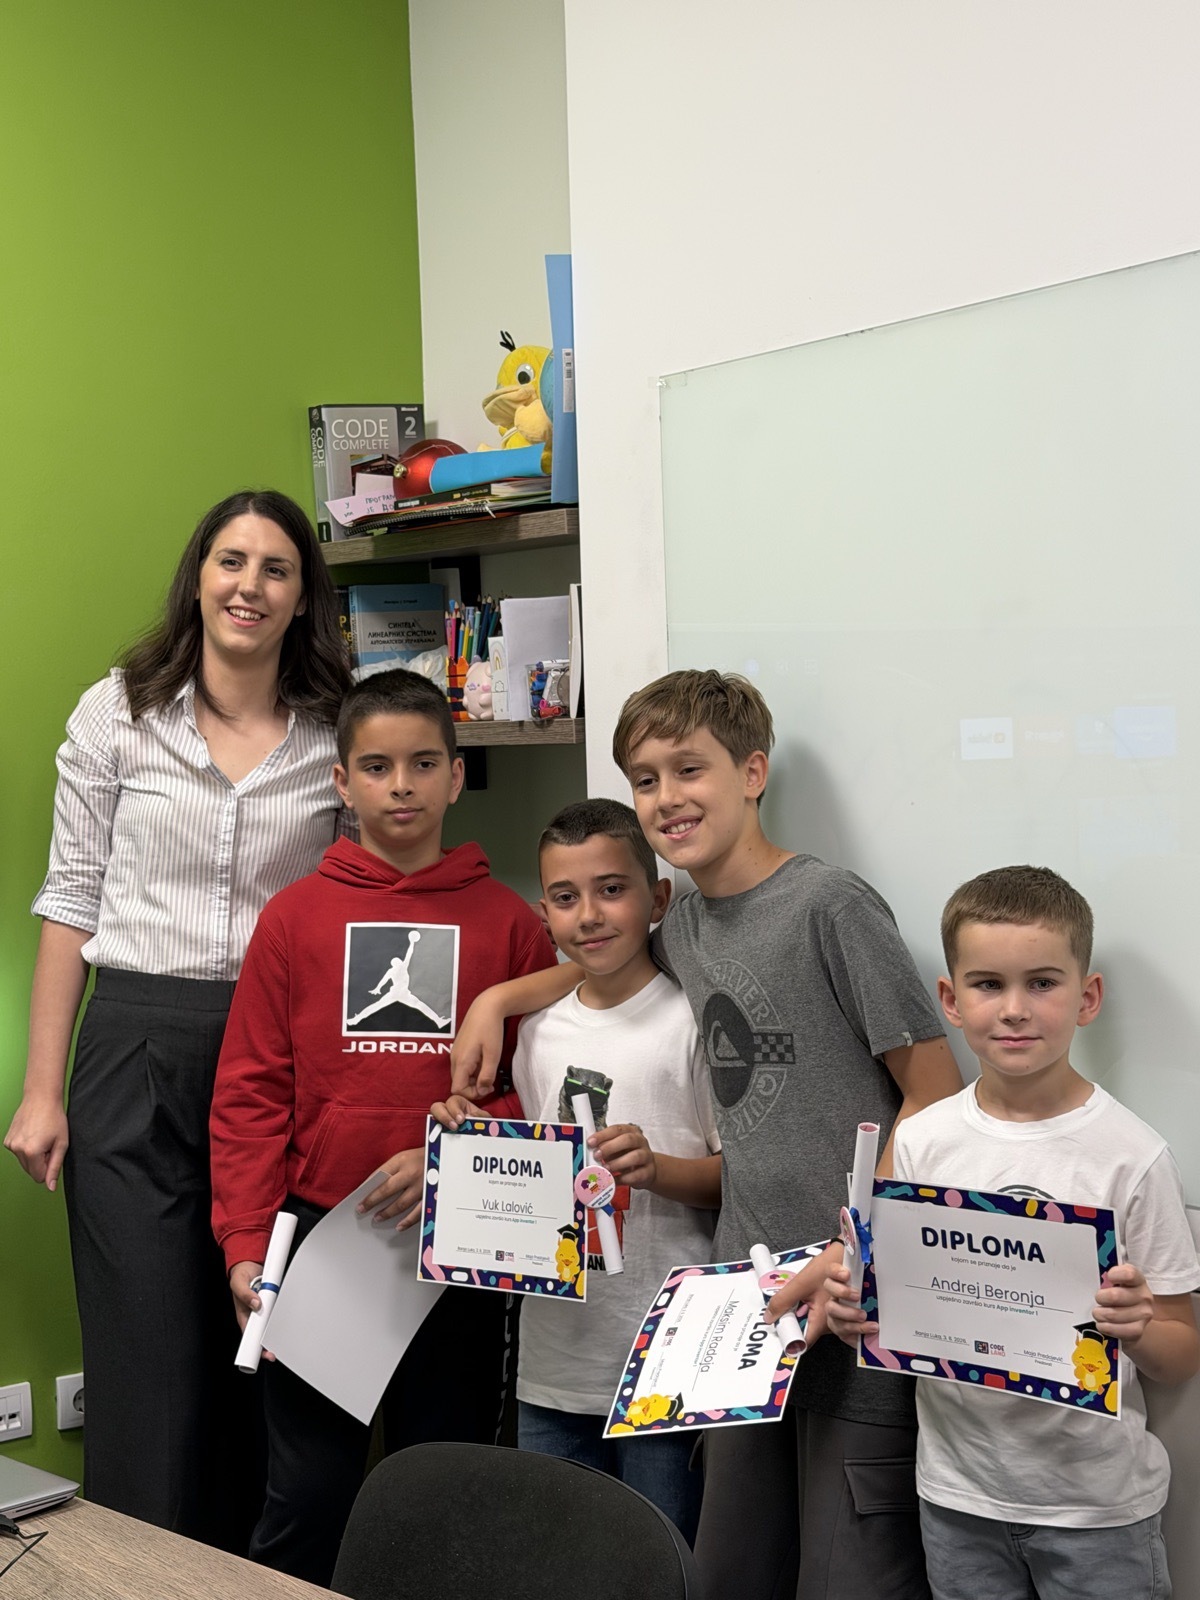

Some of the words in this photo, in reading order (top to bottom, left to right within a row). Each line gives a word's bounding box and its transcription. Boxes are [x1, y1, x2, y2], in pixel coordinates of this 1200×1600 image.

[331, 419, 389, 438] CODE
[404, 416, 417, 436] 2
[310, 428, 318, 467] COMPLETE
[315, 427, 326, 467] CODE
[332, 440, 389, 451] COMPLETE
[712, 965, 771, 1022] SILVER
[342, 1041, 453, 1054] JORDAN
[473, 1155, 543, 1179] DIPLOMA
[482, 1198, 499, 1211] Vuk
[501, 1200, 533, 1215] Lalović
[921, 1226, 1046, 1264] DIPLOMA
[931, 1276, 981, 1299] Andrej
[984, 1284, 1045, 1308] Beronja
[715, 1300, 740, 1334] Maksim
[996, 1304, 1009, 1312] App
[699, 1336, 723, 1373] Radoja
[990, 1343, 1005, 1351] CODE
